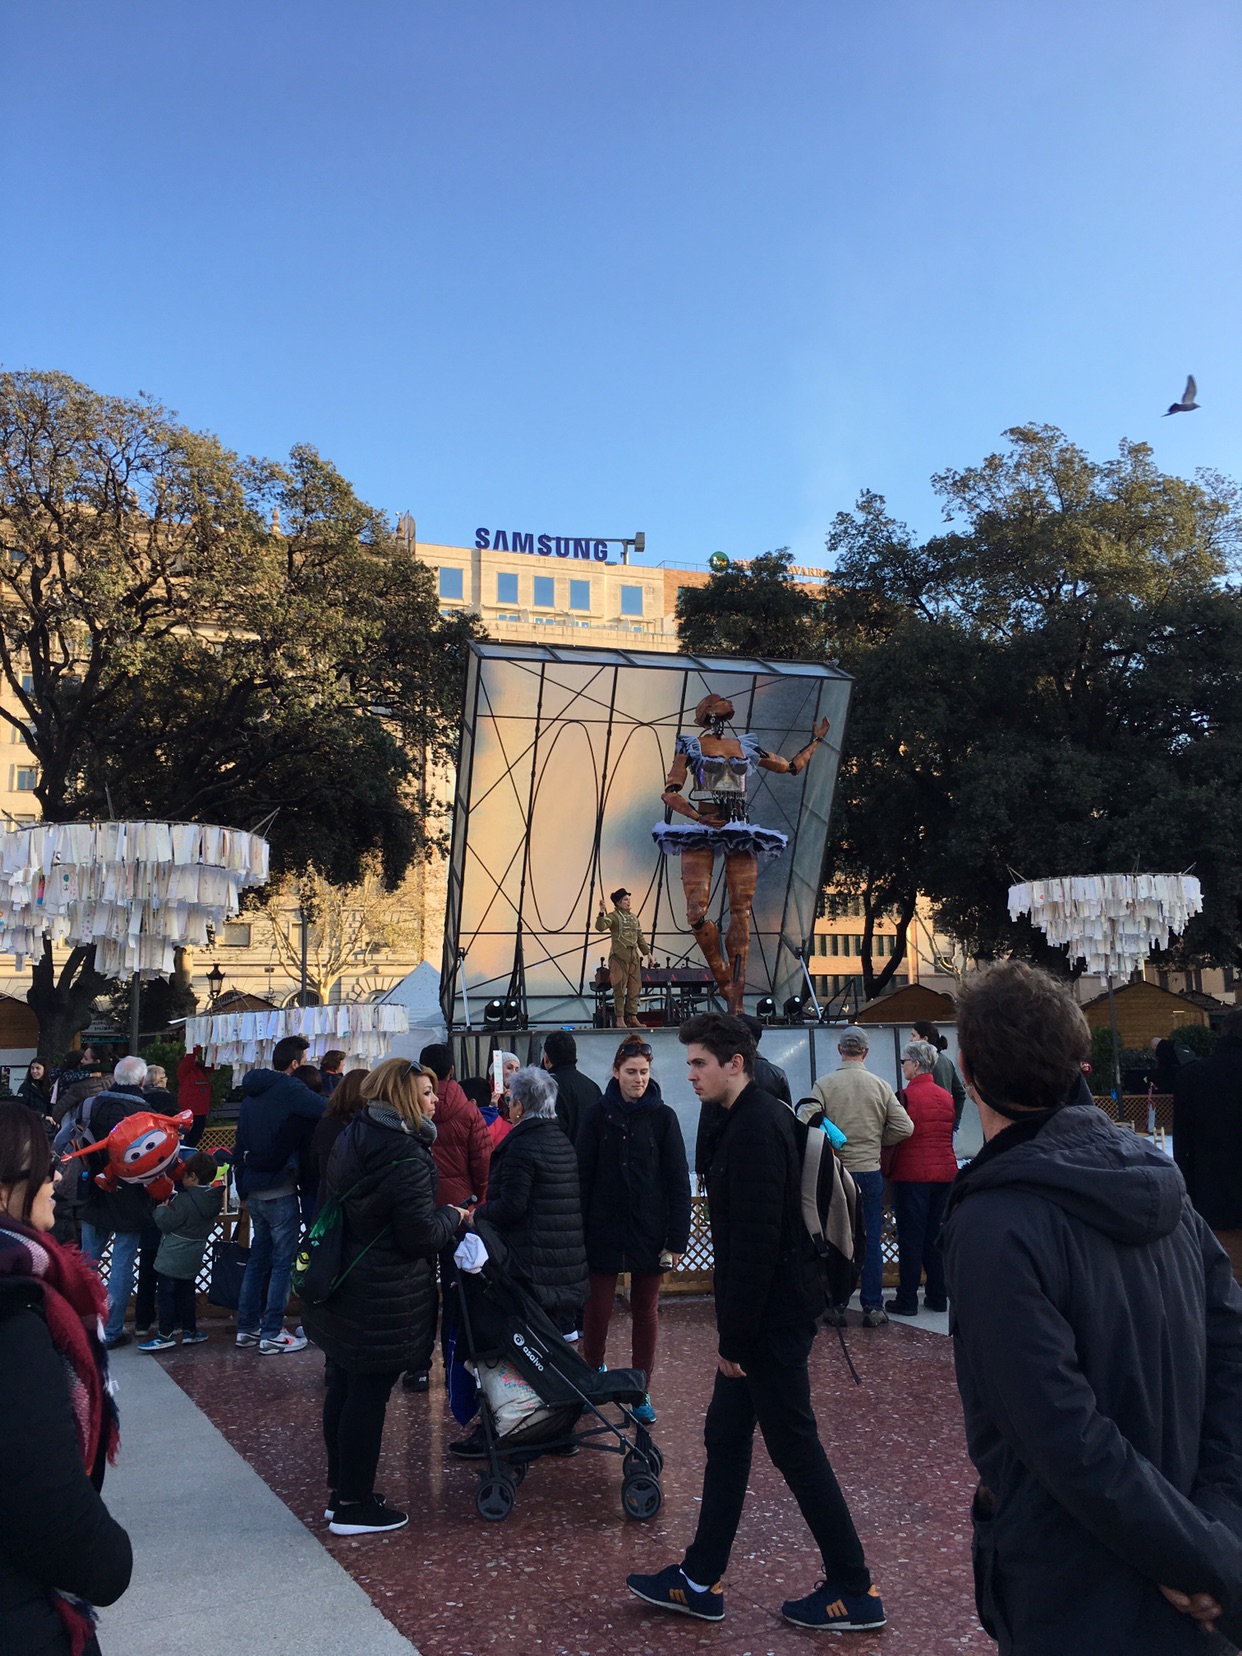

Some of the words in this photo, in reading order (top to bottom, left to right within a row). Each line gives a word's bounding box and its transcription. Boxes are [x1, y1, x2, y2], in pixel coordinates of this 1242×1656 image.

[475, 527, 608, 562] SAMSUNG
[786, 565, 831, 578] AVARR
[523, 1346, 544, 1372] asalvo
